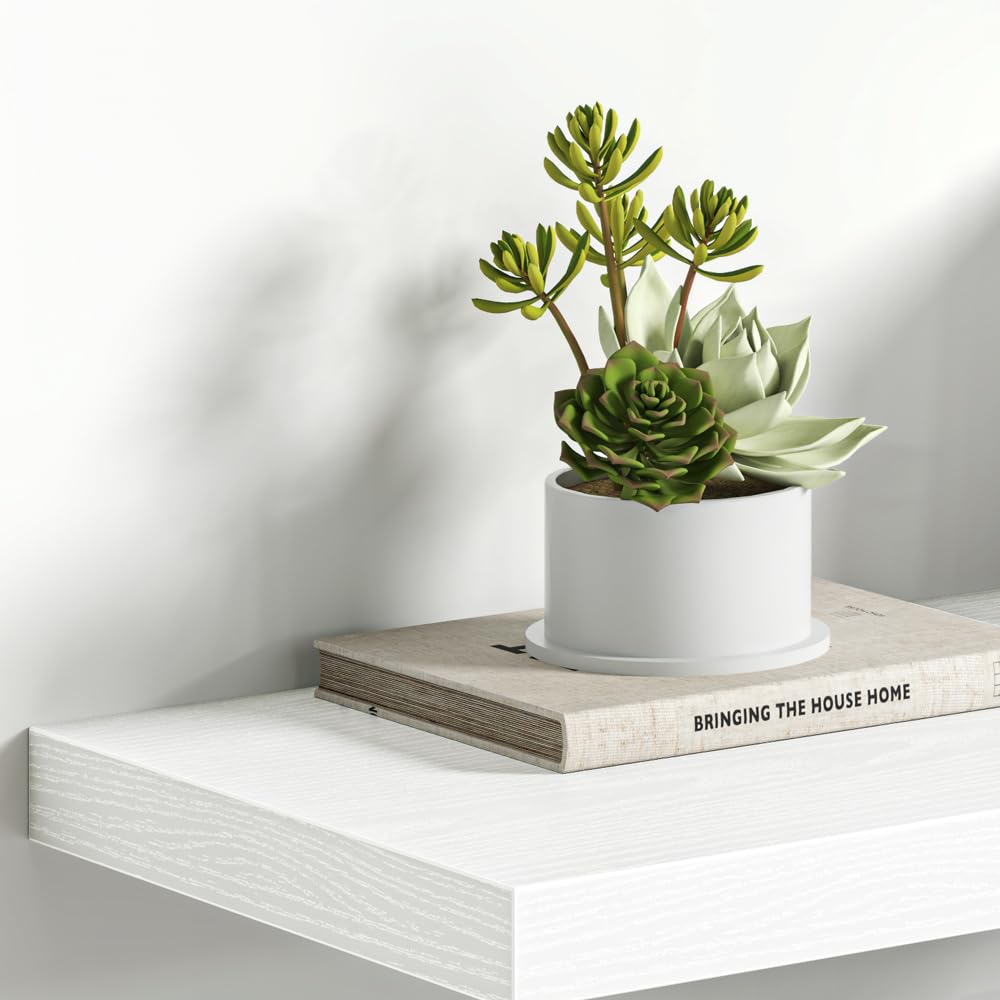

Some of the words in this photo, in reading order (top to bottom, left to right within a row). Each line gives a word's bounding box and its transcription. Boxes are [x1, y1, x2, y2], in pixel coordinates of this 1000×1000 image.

[694, 704, 771, 732] BRINGING
[776, 700, 806, 718] THE
[811, 691, 862, 713] HOUSE
[867, 683, 911, 705] HOME
